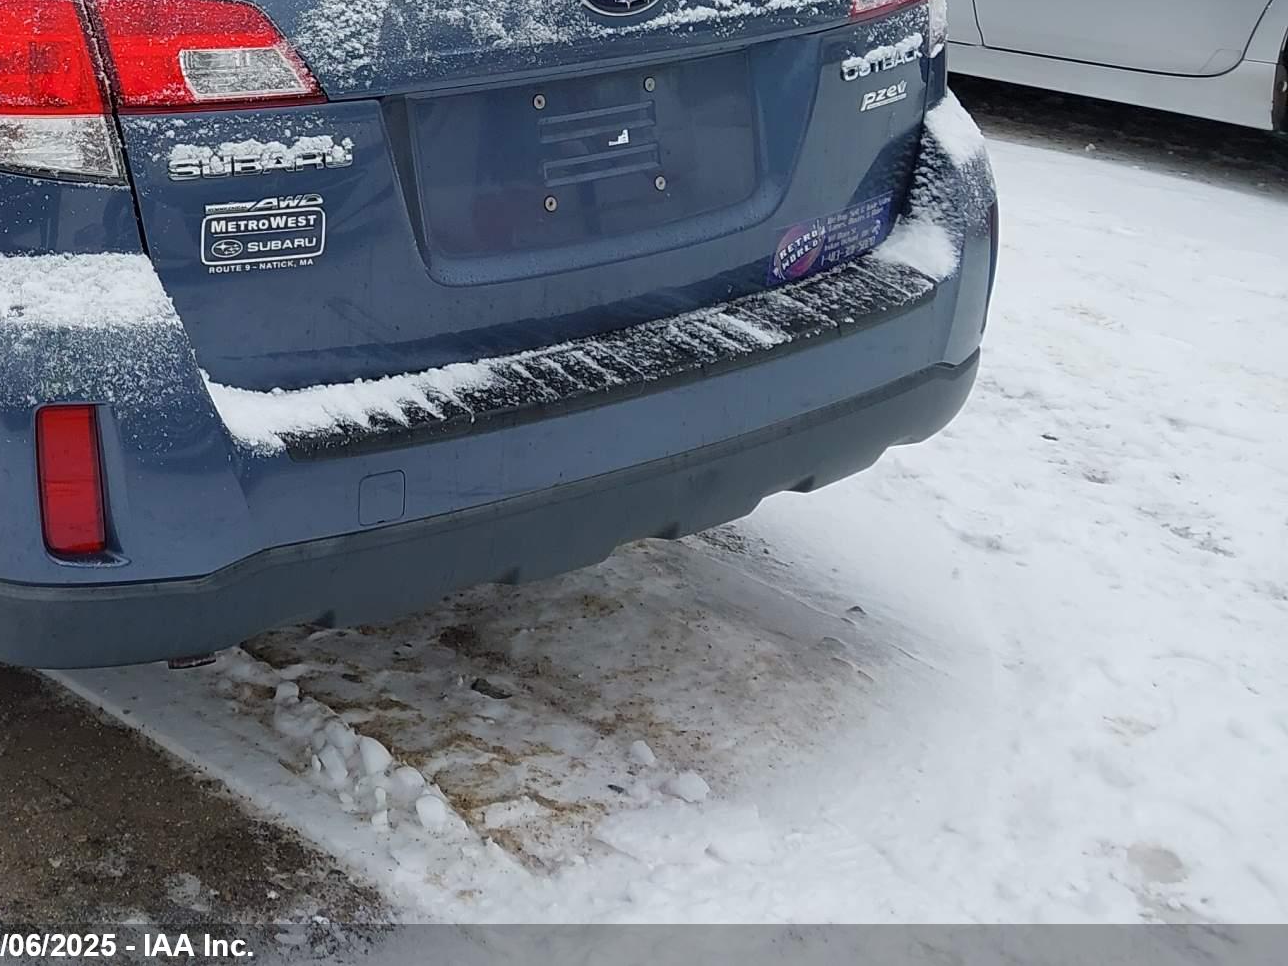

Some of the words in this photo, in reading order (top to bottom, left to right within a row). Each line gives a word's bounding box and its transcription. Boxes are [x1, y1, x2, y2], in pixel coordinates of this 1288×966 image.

[841, 46, 923, 81] OUTBACK
[168, 147, 353, 181] SUBARU
[249, 193, 324, 211] AWD
[247, 237, 317, 252] SUBARU
[778, 229, 818, 260] RETRO
[781, 239, 819, 270] WORLD
[209, 264, 242, 274] ROUTE
[299, 258, 314, 266] MA
